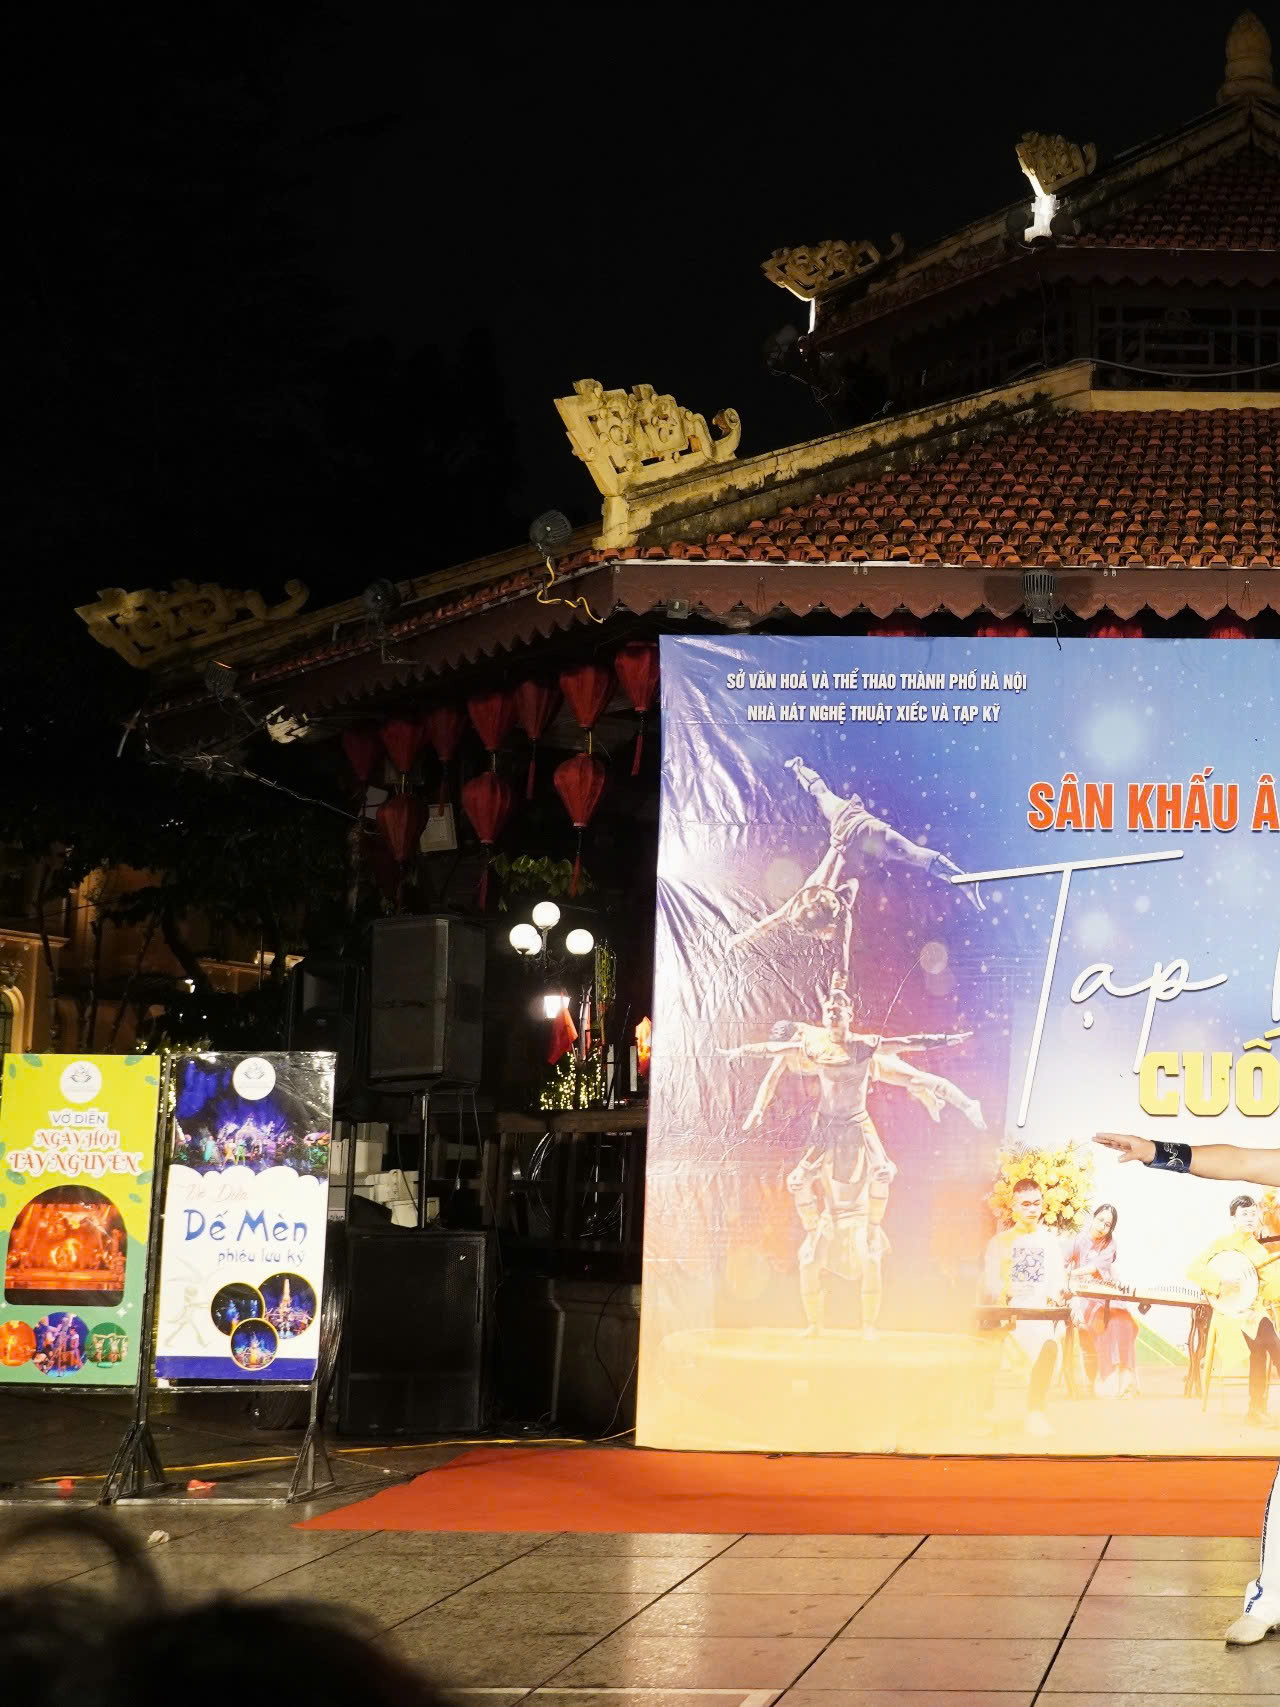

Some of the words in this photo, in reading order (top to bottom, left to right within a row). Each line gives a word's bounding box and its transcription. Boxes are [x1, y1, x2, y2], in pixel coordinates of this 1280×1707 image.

[727, 668, 745, 690] SỞ
[749, 670, 777, 690] VĂN
[780, 669, 809, 690] HOÁ
[811, 670, 830, 690] VÀ
[832, 667, 860, 690] THỂ
[862, 673, 897, 690] THAO
[900, 669, 945, 690] THÀNH
[949, 668, 978, 690] PHỐ
[980, 669, 999, 690] HÀ
[1002, 670, 1028, 694] NỘI
[747, 702, 777, 722] NHÀ
[779, 702, 806, 722] HÁT
[809, 702, 847, 726] NGHỆ
[850, 702, 893, 726] THUẬT
[895, 699, 928, 722] XIẾC
[930, 702, 950, 722] VÀ
[952, 705, 980, 726] TẠP
[982, 702, 1001, 722] KỸ
[1027, 772, 1115, 831] SÂN
[1127, 766, 1240, 832] KHẤU
[950, 849, 1228, 1127] Tạp
[184, 1209, 228, 1241] Dế
[236, 1209, 308, 1245] Mèn
